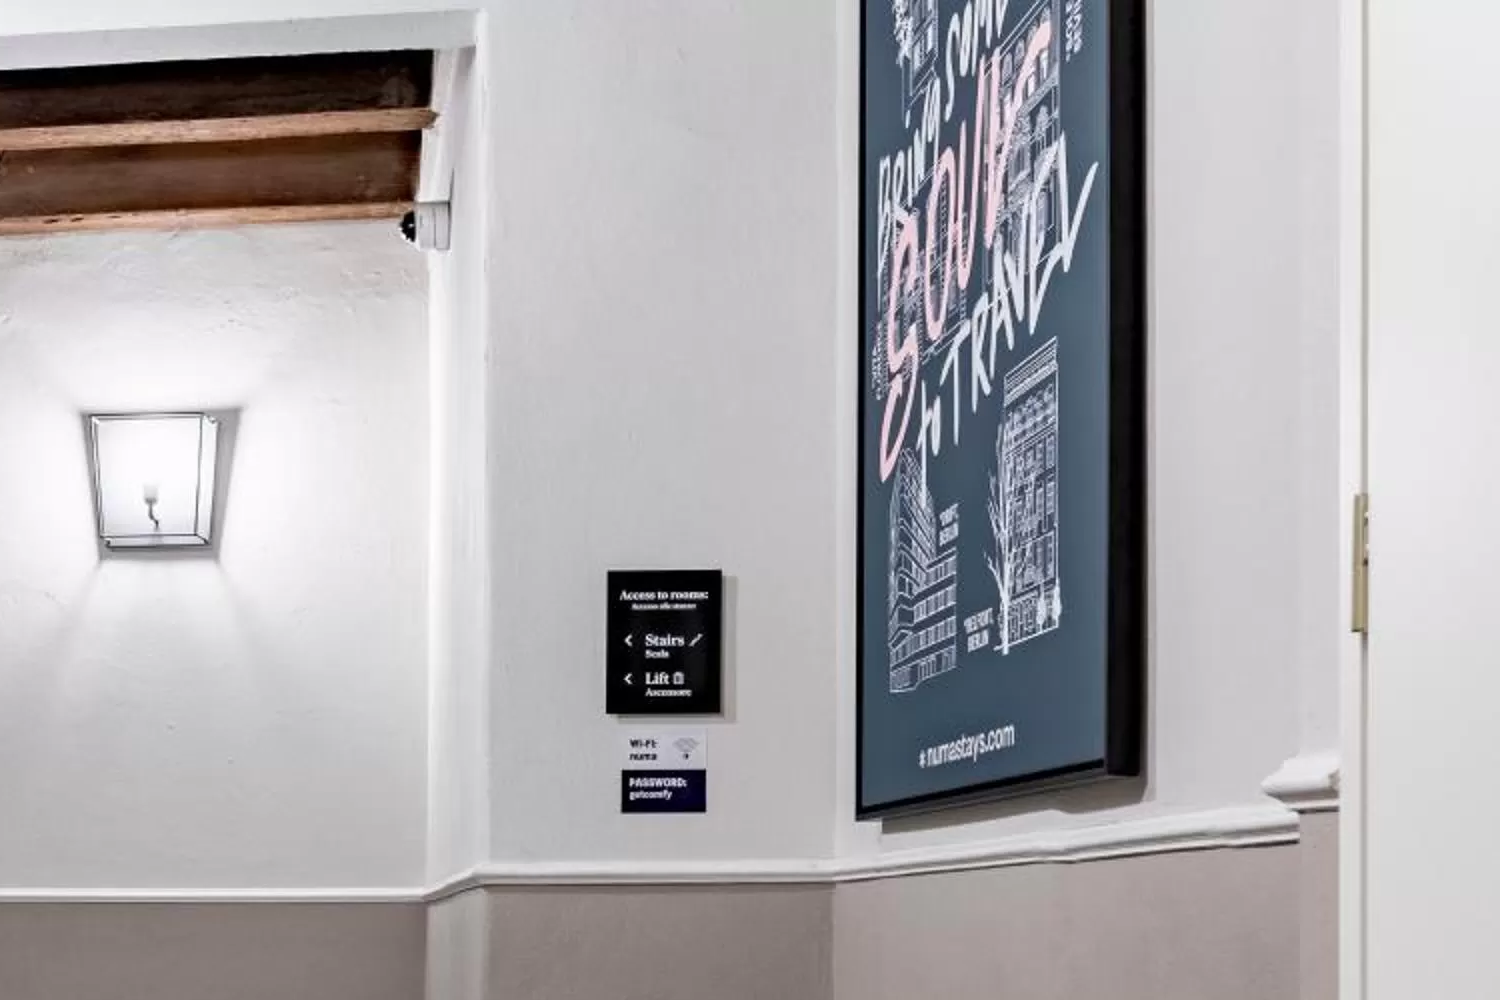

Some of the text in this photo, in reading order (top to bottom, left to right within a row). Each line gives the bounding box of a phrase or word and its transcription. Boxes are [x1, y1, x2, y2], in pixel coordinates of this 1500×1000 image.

[879, 20, 1052, 482] SOUL
[940, 130, 1099, 445] TRAVEL
[619, 589, 656, 601] Access
[657, 590, 669, 600] to
[645, 633, 685, 647] Stairs
[645, 671, 670, 685] Lift
[629, 777, 688, 788] PASSWORD:
